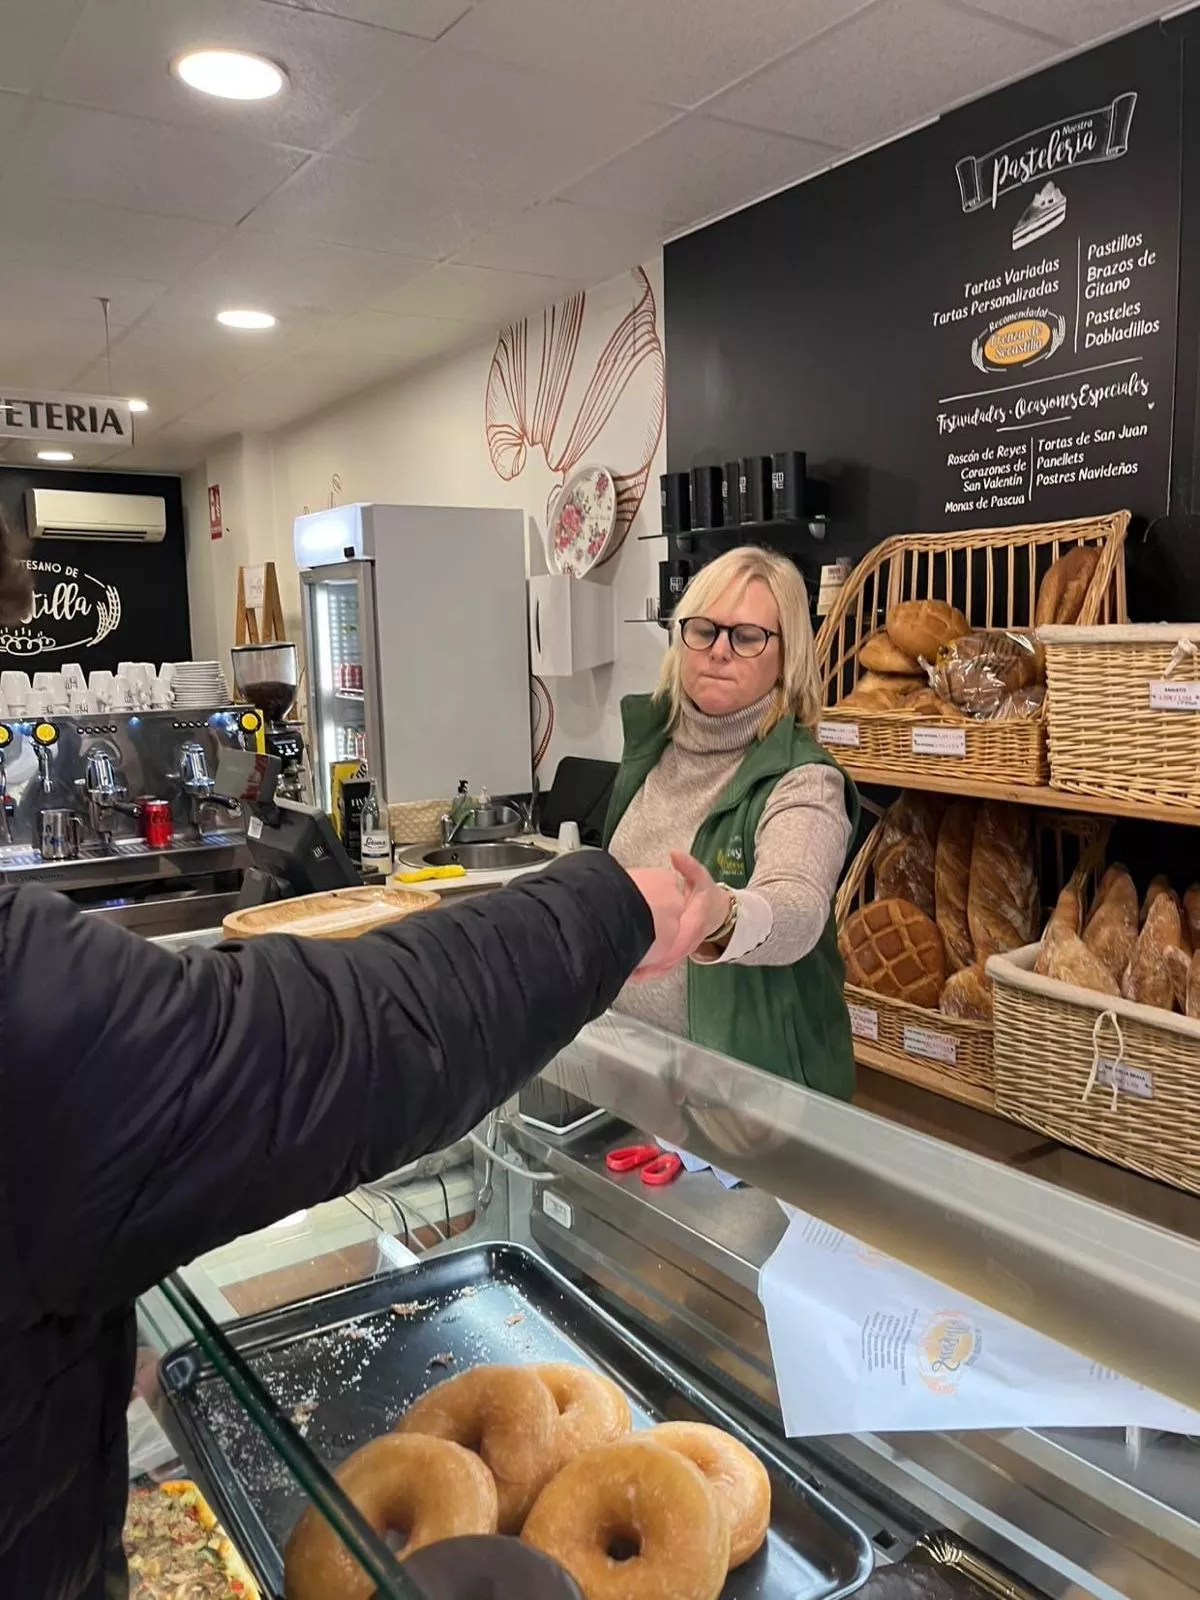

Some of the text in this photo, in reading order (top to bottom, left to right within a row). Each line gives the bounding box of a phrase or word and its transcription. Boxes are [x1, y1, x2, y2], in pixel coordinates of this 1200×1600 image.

[1062, 119, 1093, 134] Nuestra
[1088, 233, 1142, 260] Pastillos
[964, 258, 1060, 298] Tartas Variadas
[1087, 250, 1155, 282] Brazos de
[1085, 277, 1130, 300] Gitano
[933, 279, 1059, 327] Tartas Personalizadas
[1086, 302, 1141, 327] Pasteles
[1085, 318, 1159, 348] Dobladillos
[1015, 394, 1077, 419] Ocasiones
[1079, 372, 1148, 409] Especiales
[0, 399, 124, 435] ETERIA
[1076, 432, 1090, 446] de
[1094, 429, 1116, 442] San
[1118, 424, 1148, 440] Juan
[948, 443, 1027, 466] Roscón de Reyes
[1037, 452, 1084, 469] Panellets
[961, 459, 1027, 480] Corazones de
[1036, 461, 1138, 486] Postres Navideños
[964, 474, 1023, 493] San Valentín
[945, 494, 1025, 513] Monas de Pascua
[65, 566, 79, 578] DE
